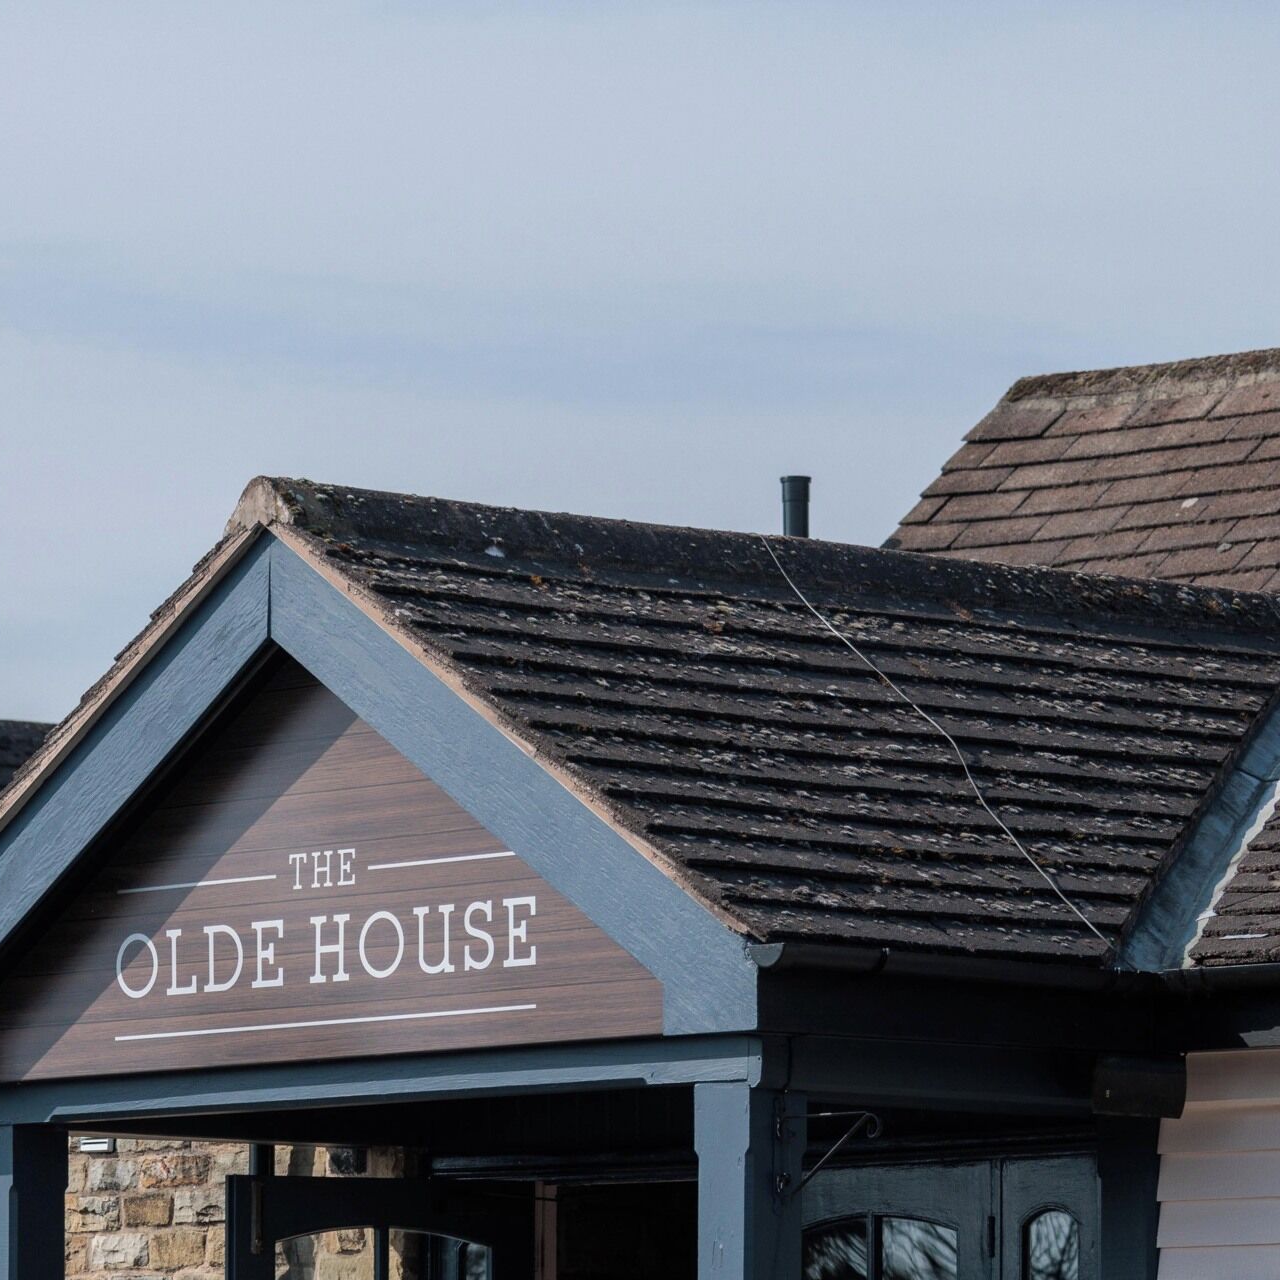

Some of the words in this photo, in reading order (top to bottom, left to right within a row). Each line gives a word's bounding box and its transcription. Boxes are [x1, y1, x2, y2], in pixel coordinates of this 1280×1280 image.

[288, 848, 356, 890] THE
[116, 919, 284, 999] OLDE
[309, 896, 537, 984] HOUSE
